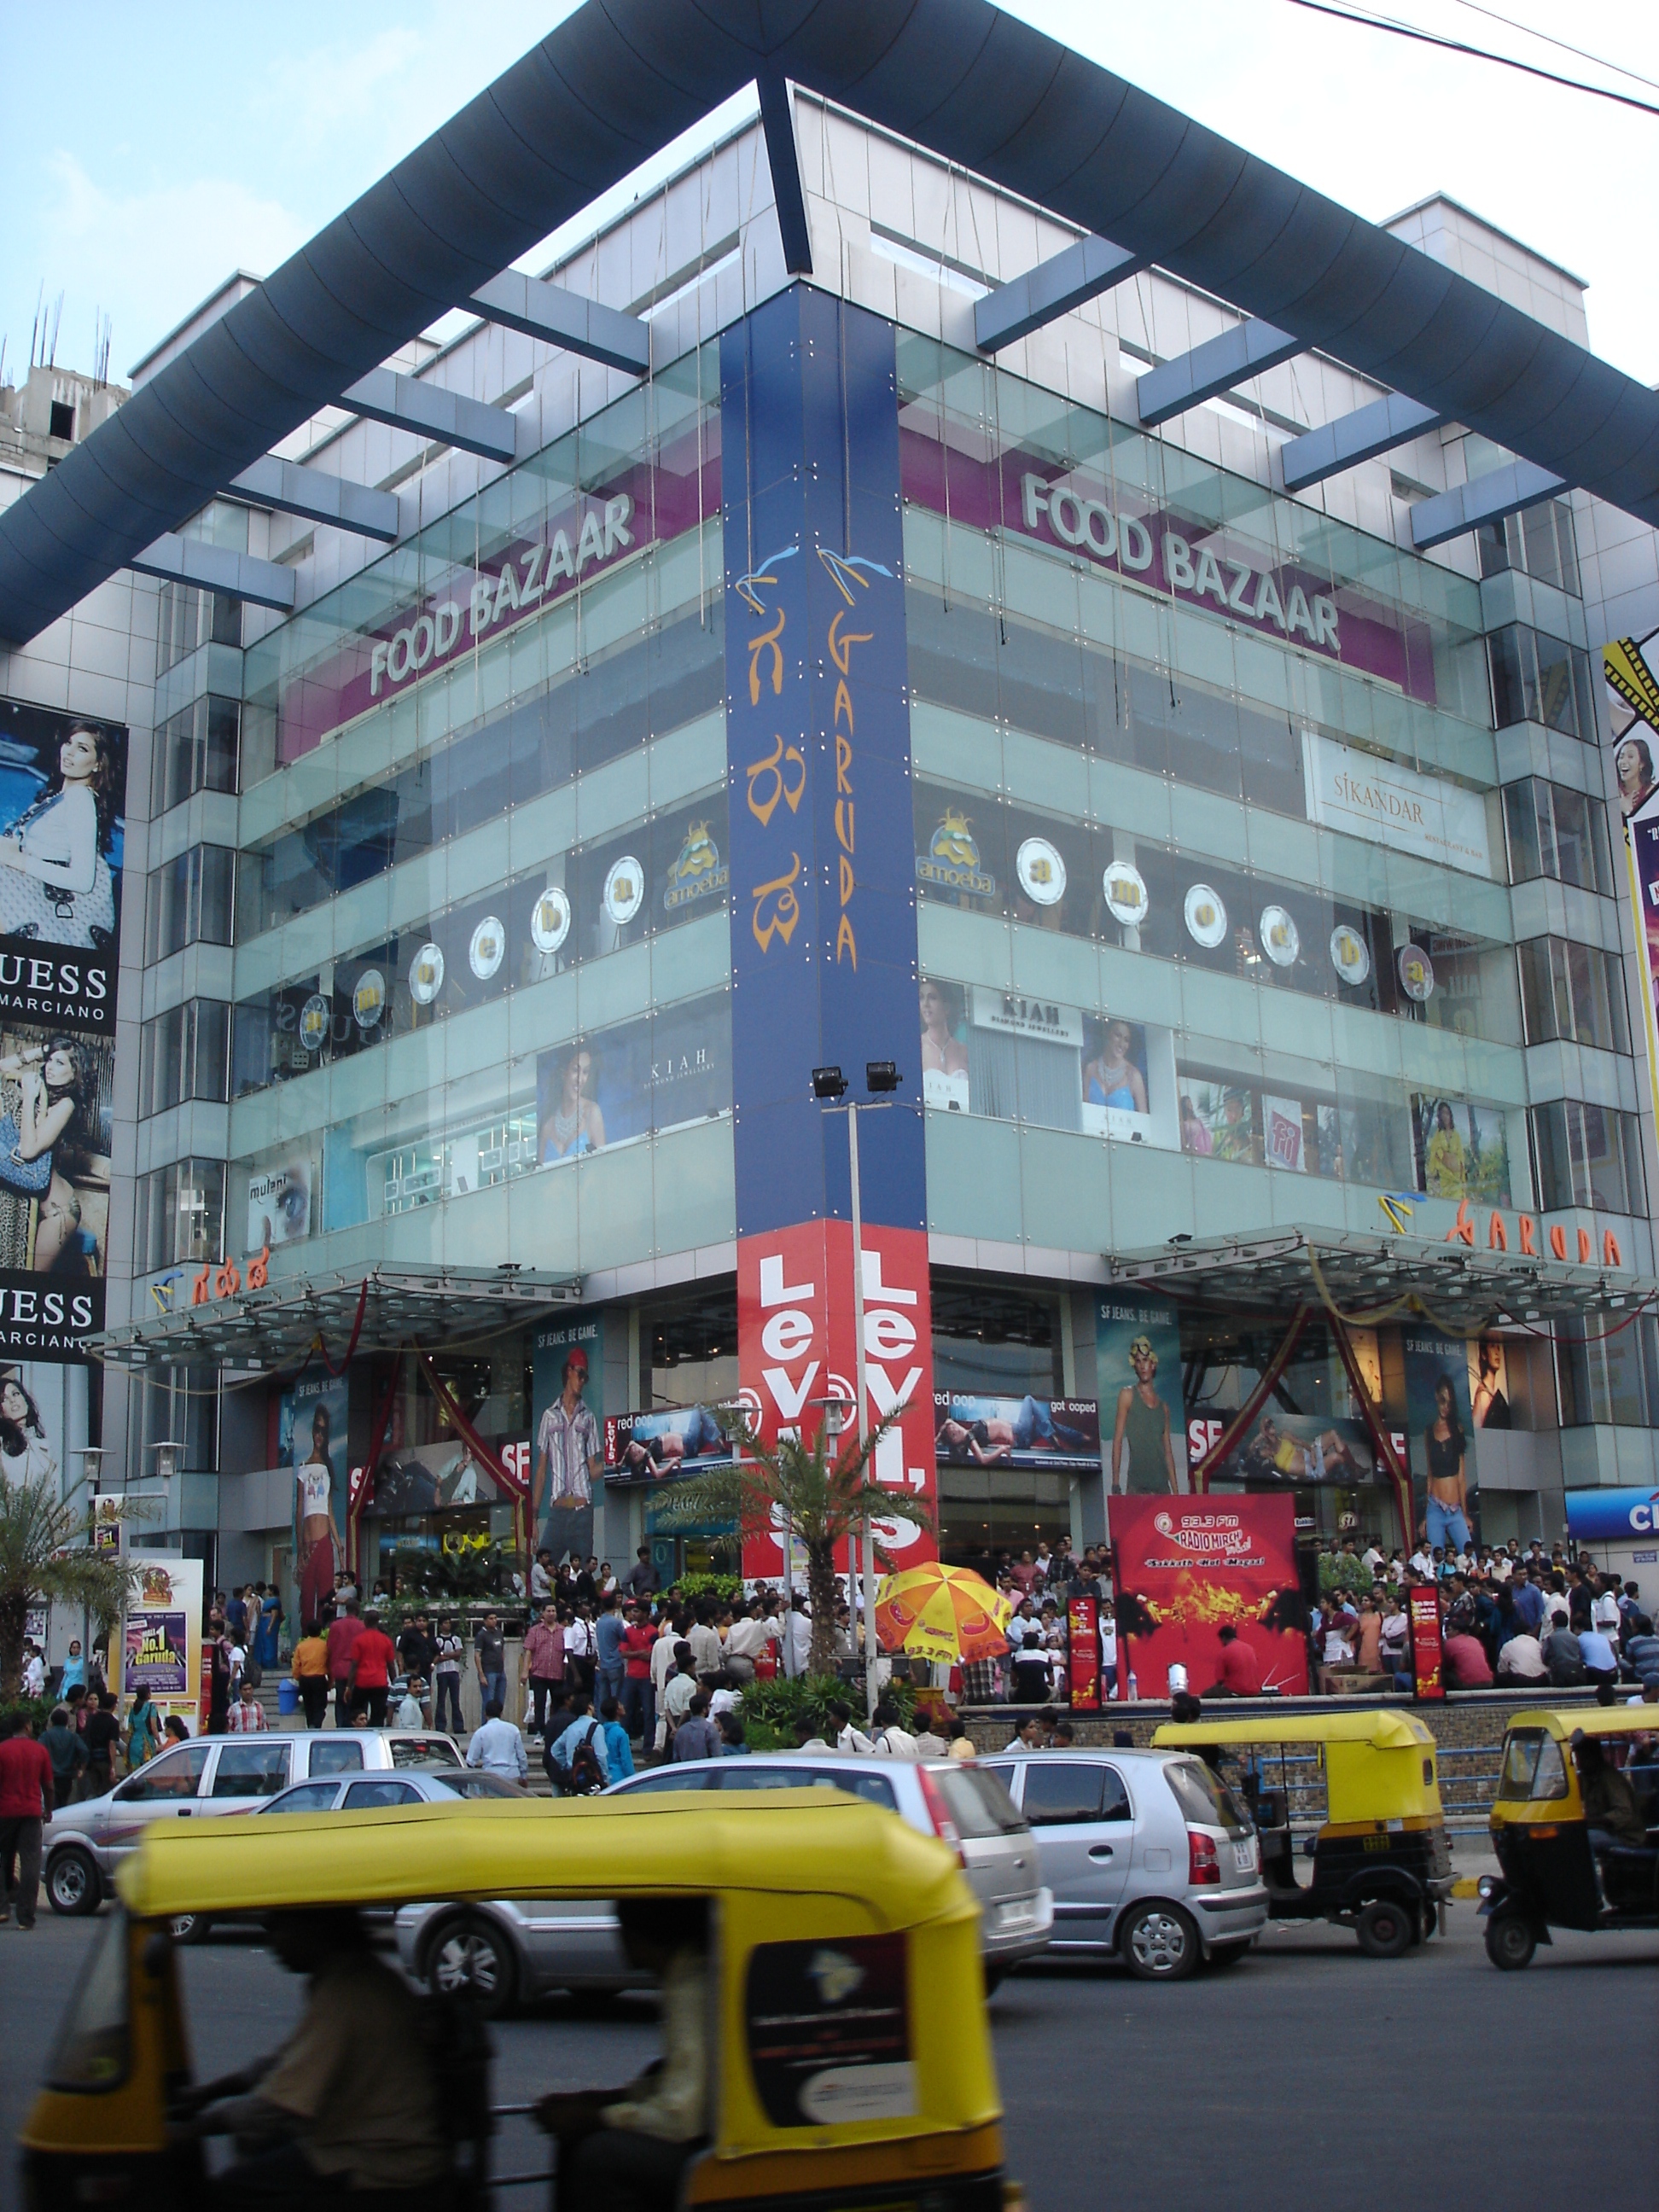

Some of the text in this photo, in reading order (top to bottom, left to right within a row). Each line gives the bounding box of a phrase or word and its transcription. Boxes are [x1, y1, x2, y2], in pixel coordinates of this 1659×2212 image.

[1021, 472, 1342, 652] FOOD BAZAAR
[370, 492, 636, 696] FOOD BAZAAR
[828, 610, 874, 973] GARUDA
[666, 869, 728, 906] amoeba
[919, 861, 992, 894] amoeba
[1002, 997, 1060, 1026] KIAH
[651, 1049, 706, 1079] KIAH
[1446, 1197, 1621, 1267] GARUDA
[617, 1415, 632, 1430] red
[1051, 1400, 1065, 1412] got
[1189, 1419, 1223, 1458] SF
[502, 1441, 530, 1481] SF
[1180, 1514, 1239, 1528] 93.3 FM
[1179, 1530, 1210, 1551] RADIO
[135, 1649, 176, 1665] Garuda
